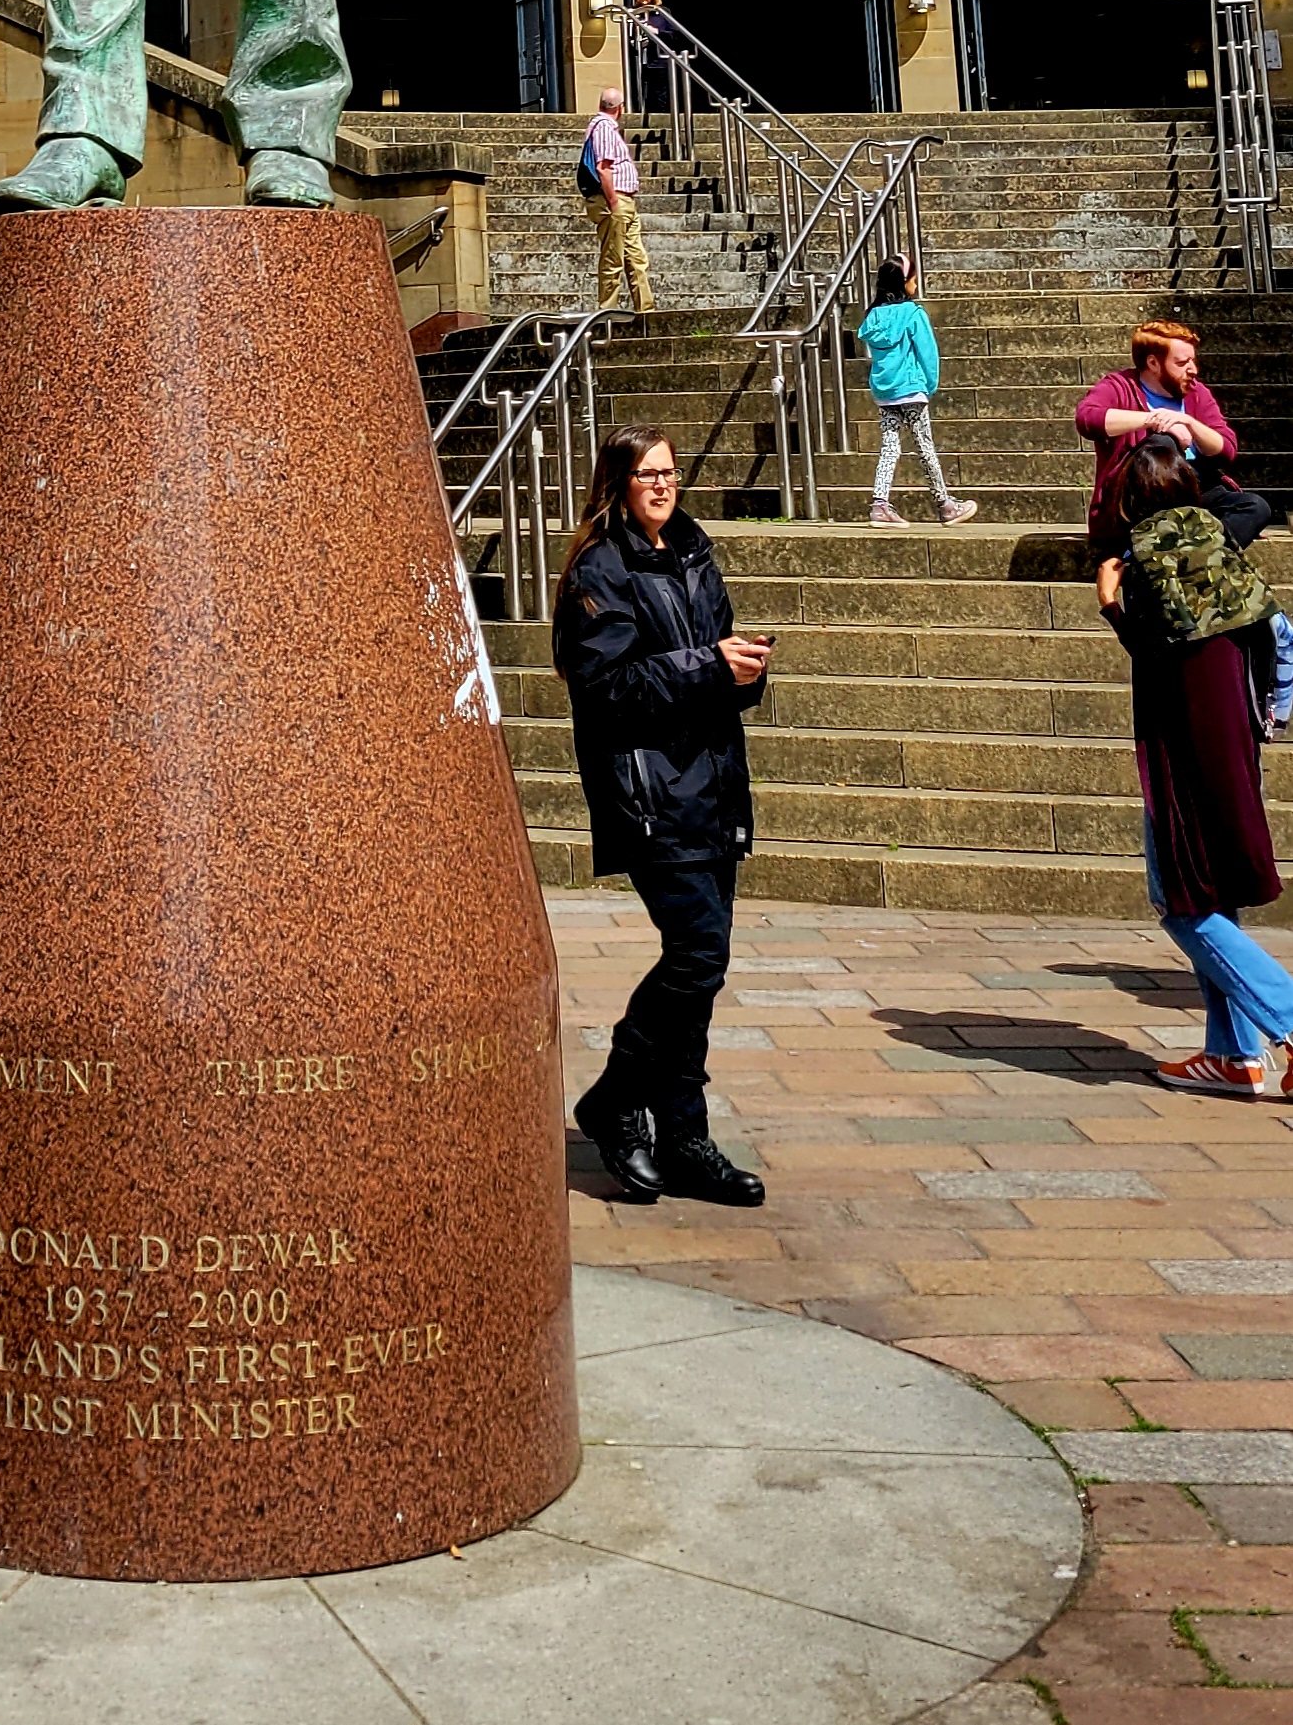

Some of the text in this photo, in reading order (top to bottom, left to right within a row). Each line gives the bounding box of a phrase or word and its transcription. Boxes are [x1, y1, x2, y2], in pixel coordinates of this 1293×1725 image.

[206, 1054, 357, 1096] THERE
[193, 1228, 357, 1272] DEWAR
[45, 1284, 135, 1328] 1937
[187, 1287, 290, 1328] 2000
[185, 1323, 447, 1384] FIRST-EVER
[123, 1392, 362, 1440] MINISTER
